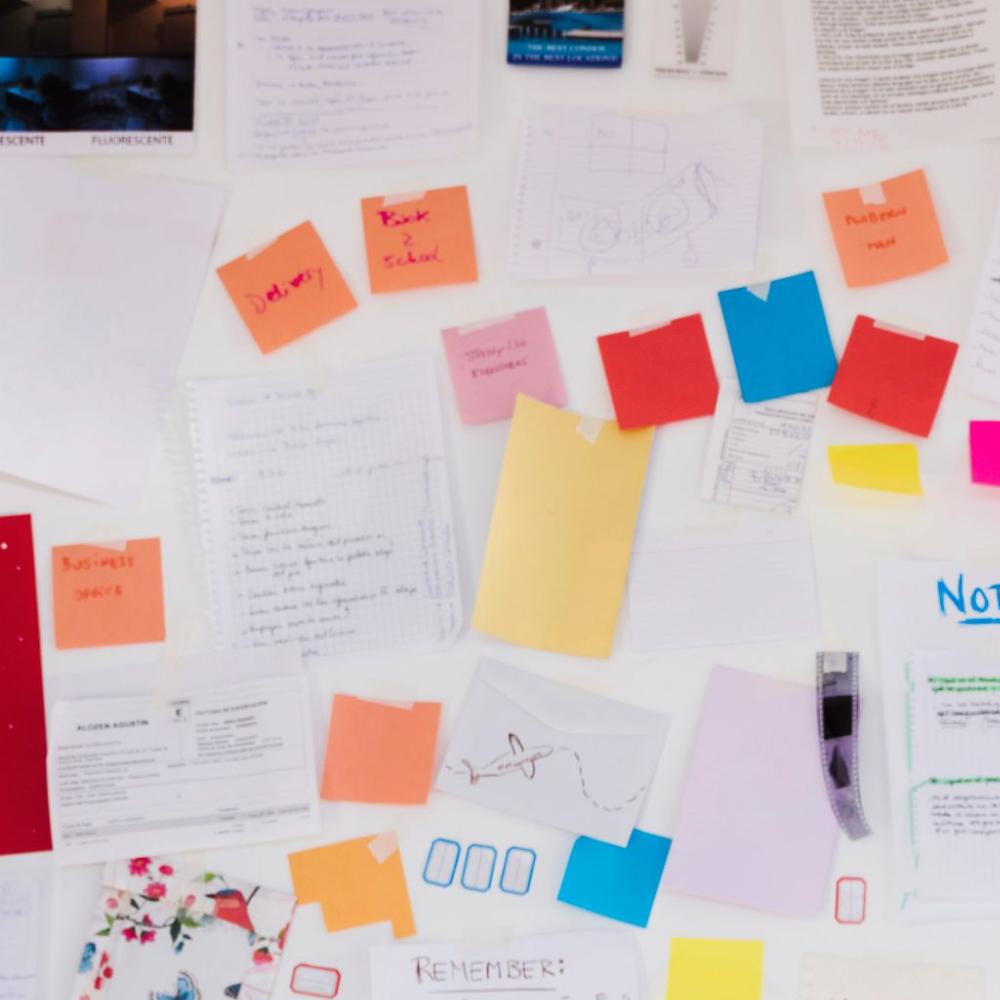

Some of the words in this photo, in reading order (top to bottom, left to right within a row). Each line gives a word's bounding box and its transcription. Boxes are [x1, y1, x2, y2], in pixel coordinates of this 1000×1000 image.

[91, 136, 174, 146] FLUORESCENTE
[246, 267, 325, 314] Delivery
[412, 956, 566, 984] REMEMBER:
